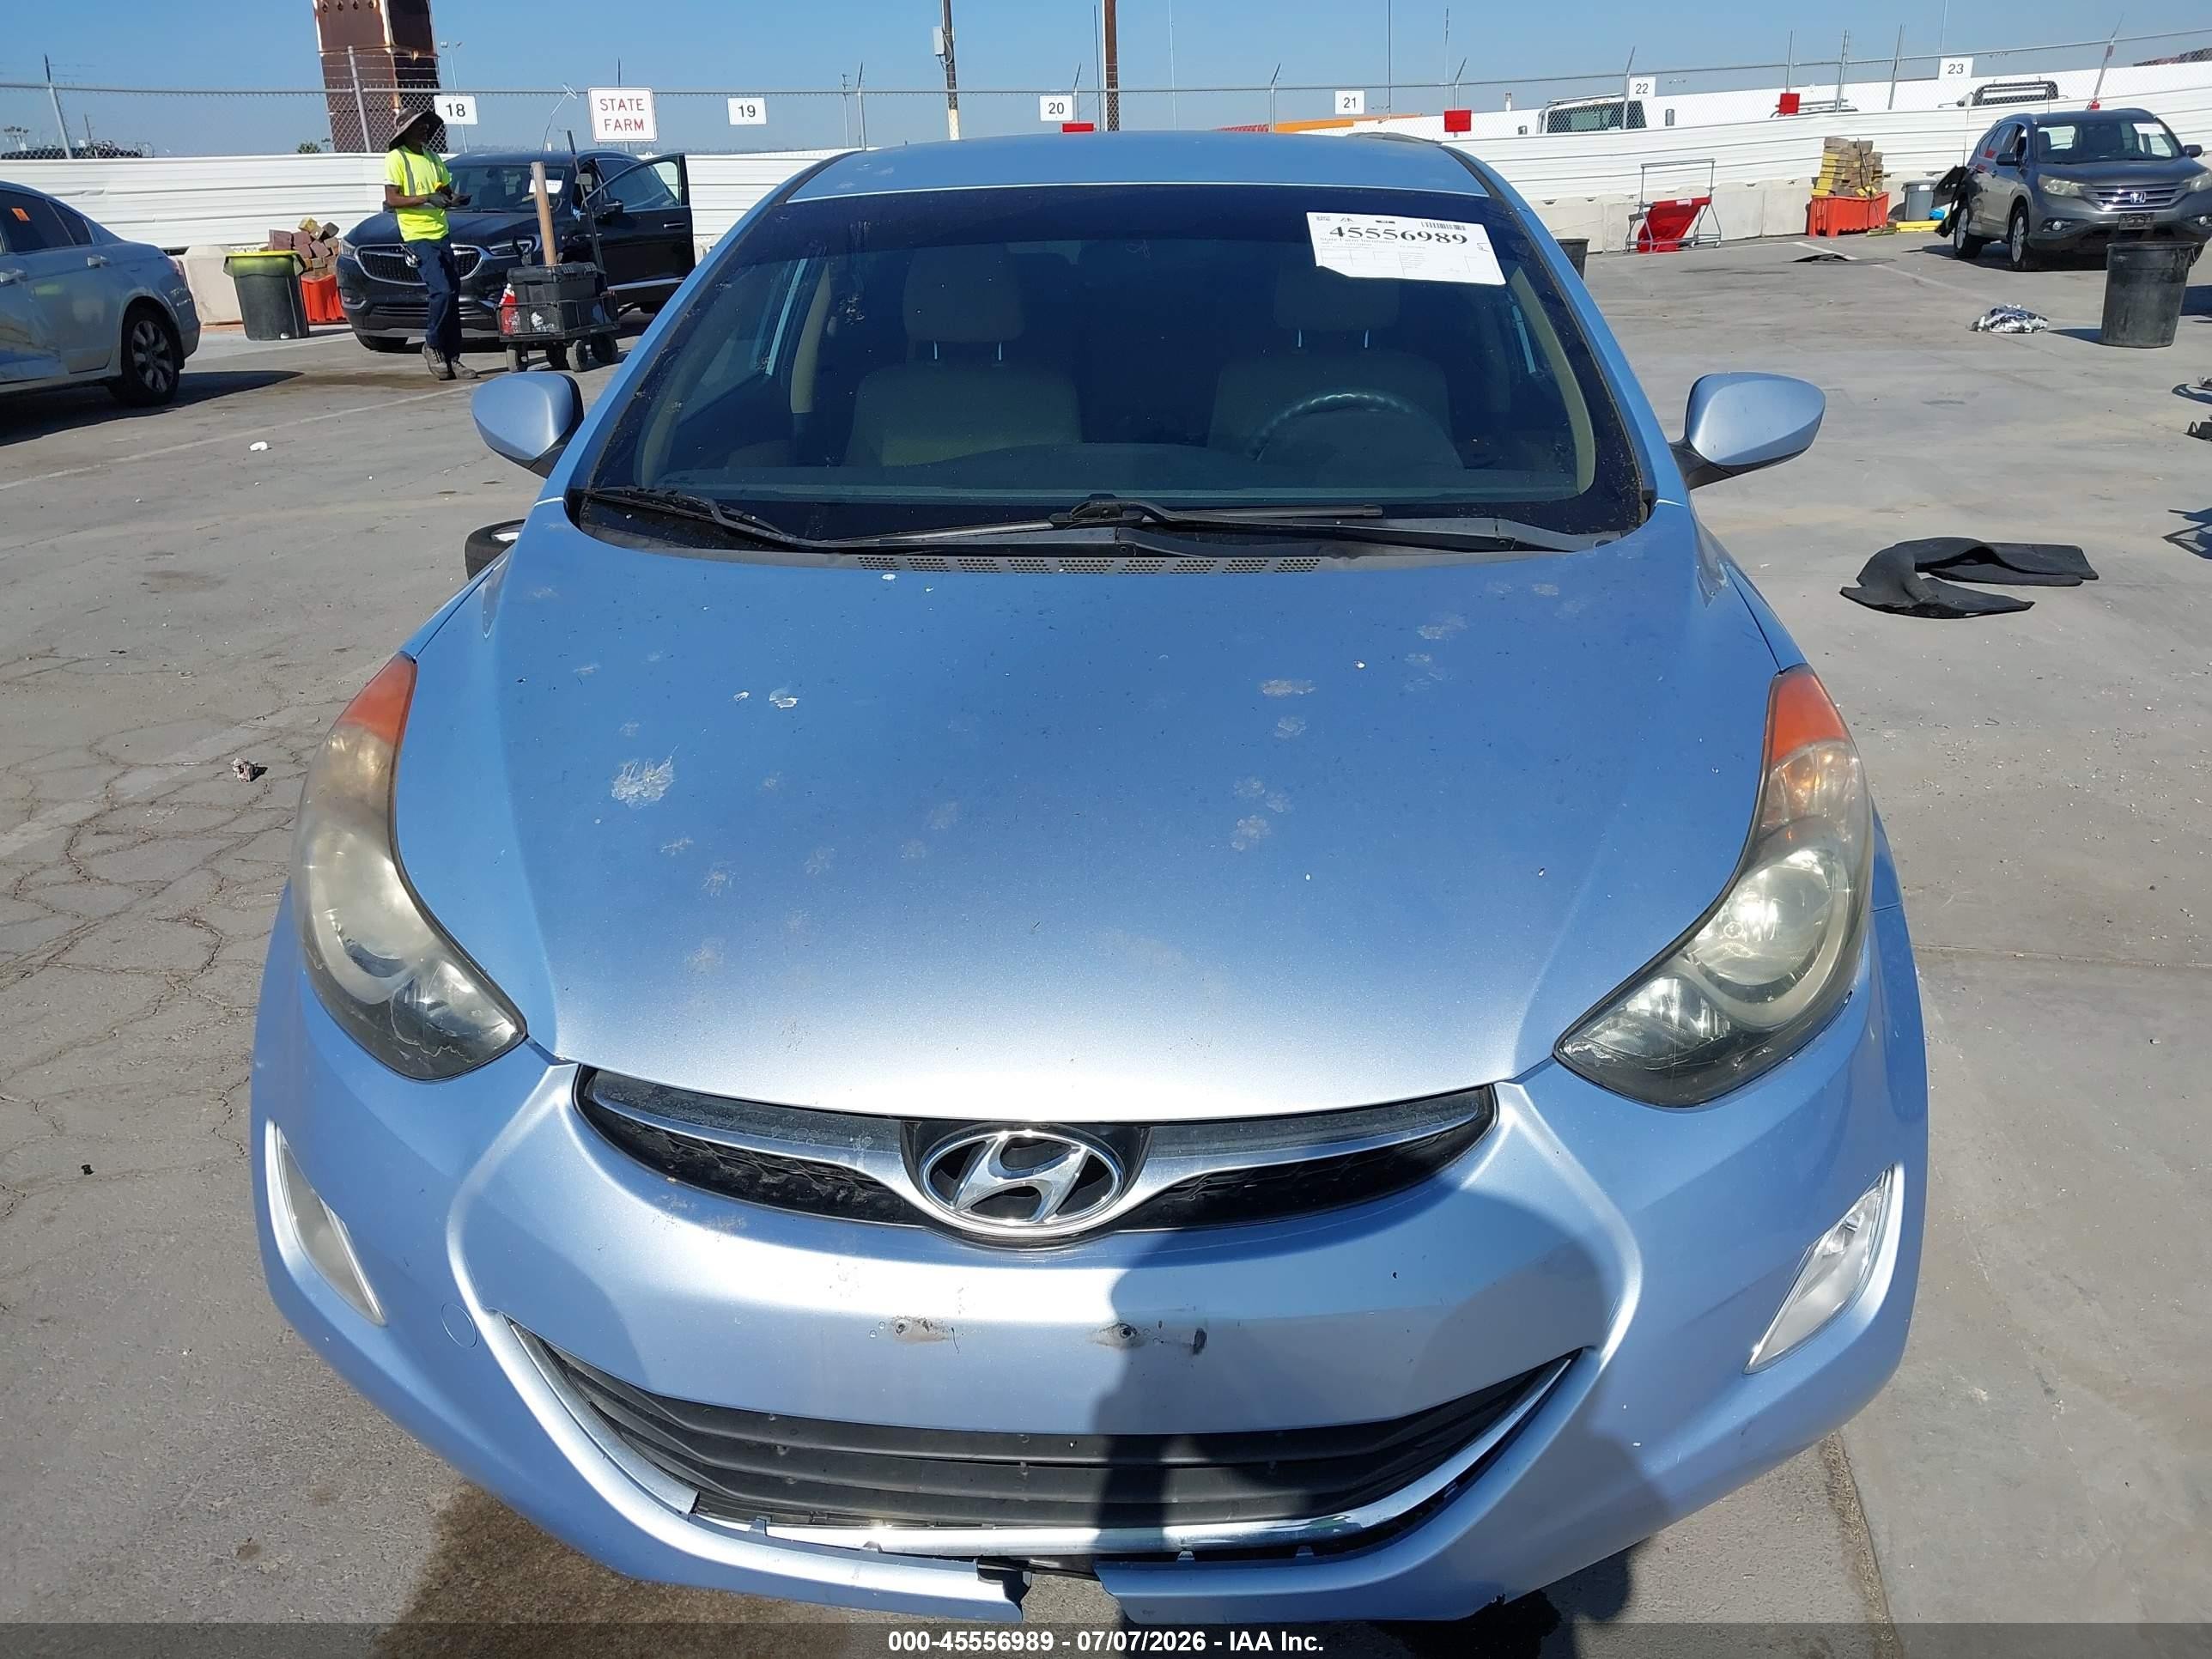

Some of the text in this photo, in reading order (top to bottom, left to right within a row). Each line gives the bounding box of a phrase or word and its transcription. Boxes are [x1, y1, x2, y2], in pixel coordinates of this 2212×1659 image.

[1948, 63, 1964, 75] 23
[1635, 82, 1649, 94] 22
[599, 98, 645, 112] STATE
[1048, 102, 1065, 114] 20
[1343, 96, 1357, 109] 21
[446, 102, 466, 118] 18
[738, 105, 757, 118] 19
[604, 118, 645, 131] FARM
[1329, 226, 1468, 245] 45556989
